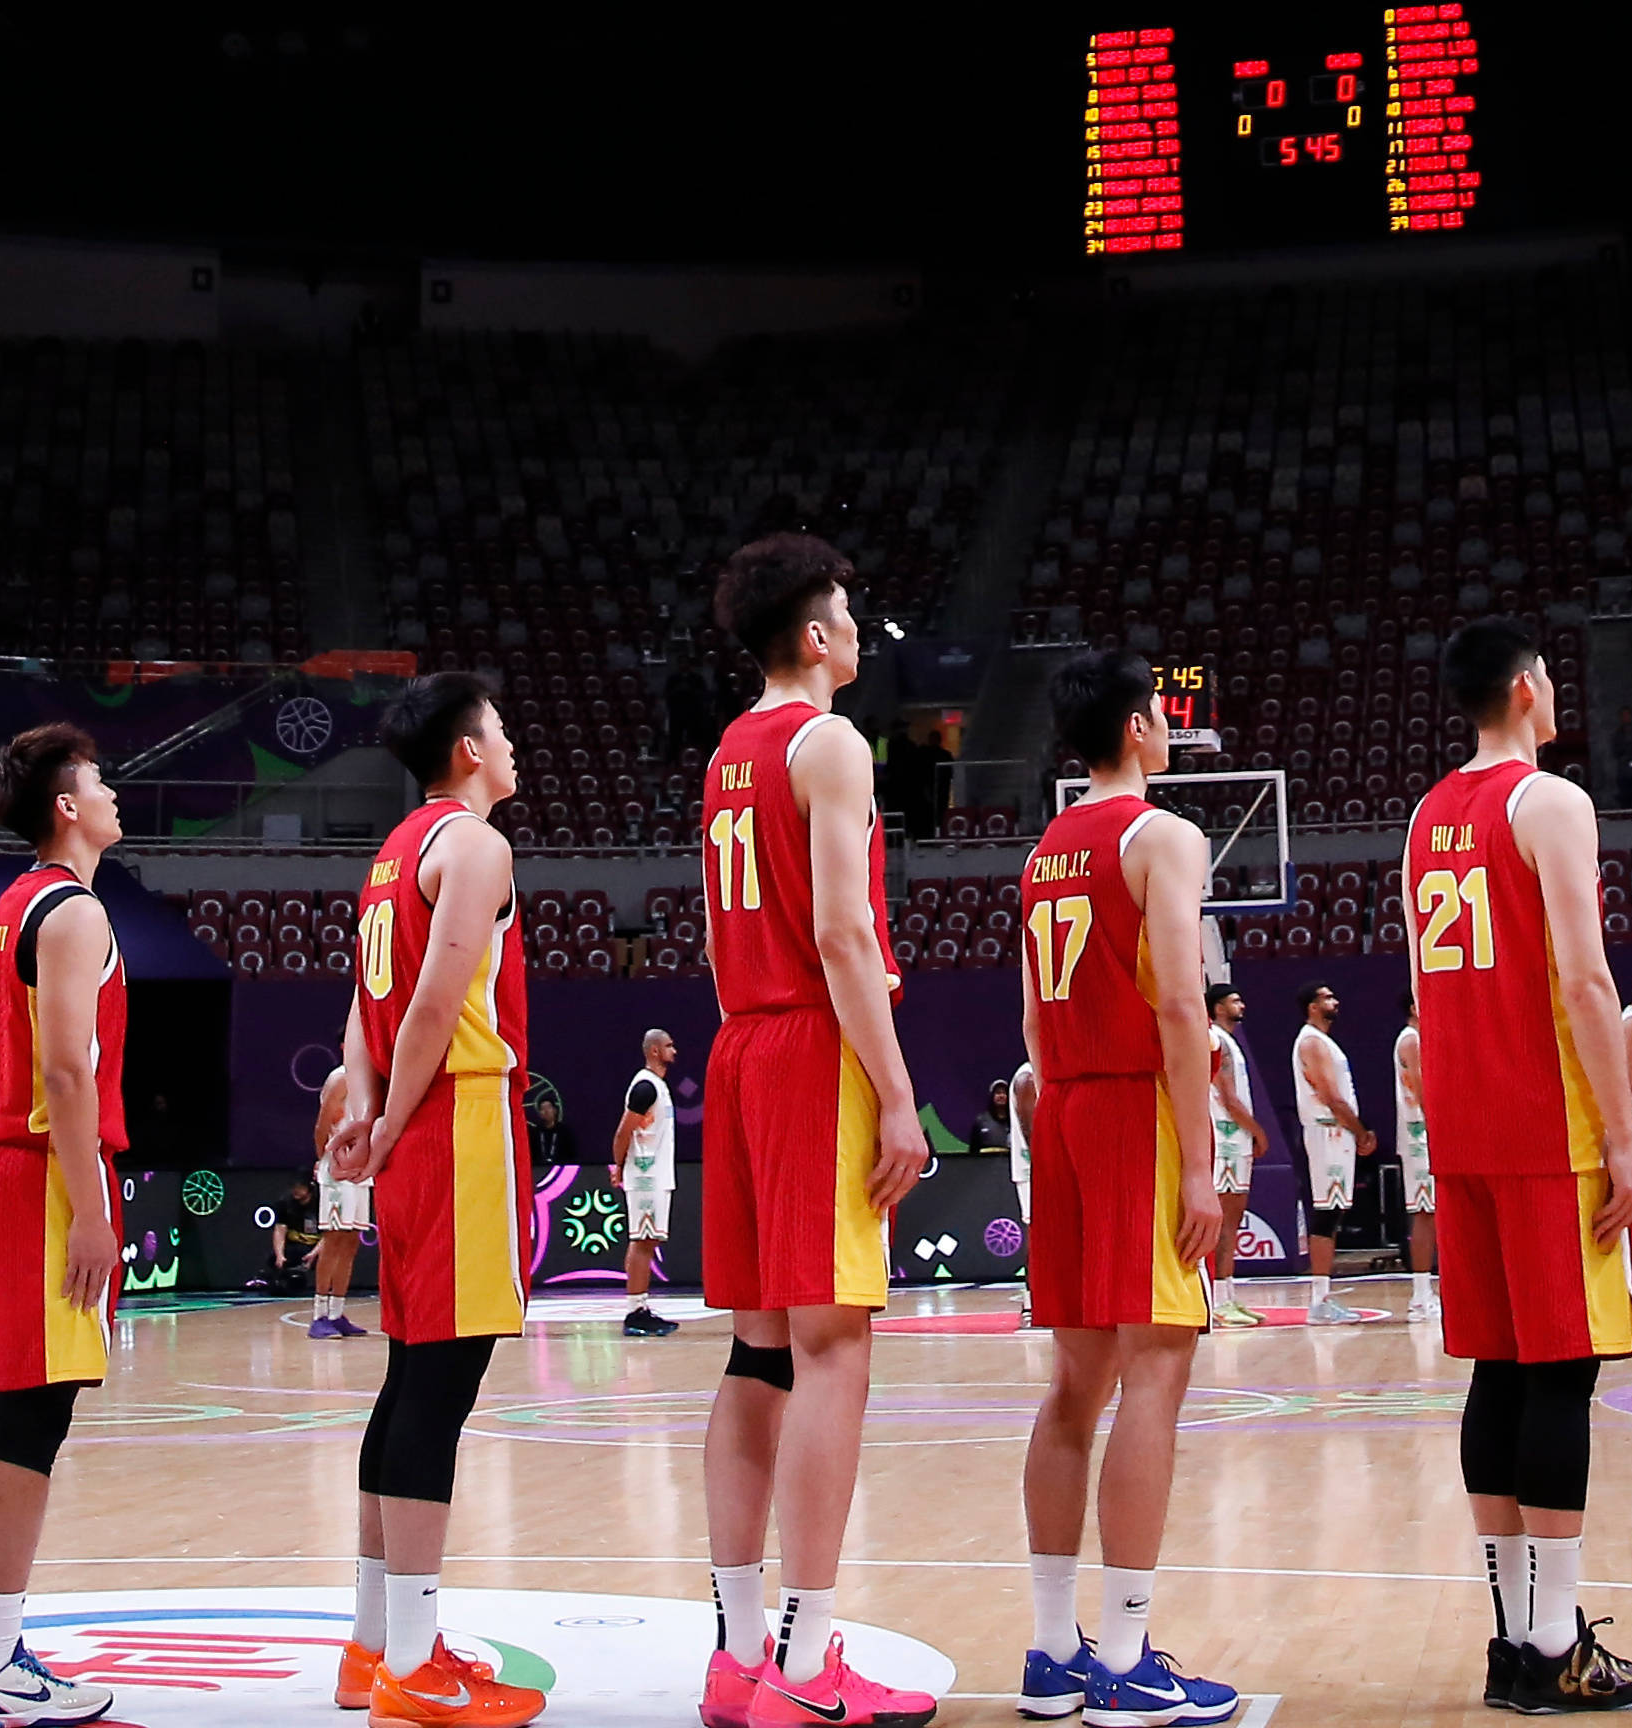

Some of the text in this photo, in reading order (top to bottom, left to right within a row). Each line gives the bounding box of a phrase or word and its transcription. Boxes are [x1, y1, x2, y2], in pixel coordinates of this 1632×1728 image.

[1086, 53, 1096, 66] 5
[1387, 46, 1397, 59] 5
[1266, 80, 1286, 108] 0
[1336, 74, 1356, 103] 0
[1238, 114, 1252, 135] 0
[1347, 105, 1361, 127] 0
[1388, 122, 1402, 135] 11
[1389, 140, 1404, 154] 17
[1087, 164, 1102, 177] 17
[1386, 160, 1405, 173] 21
[1084, 201, 1103, 215] 23
[1389, 197, 1407, 211] 35
[1085, 221, 1104, 234] 24
[1391, 216, 1409, 230] 39
[1086, 240, 1105, 253] 34
[1173, 666, 1203, 689] 45
[721, 764, 737, 791] YU
[1431, 826, 1454, 852] HU
[709, 806, 761, 911] 11
[1032, 850, 1091, 883] ZHAO J.Y.
[1417, 866, 1495, 973] 21
[358, 899, 394, 1000] 10
[1027, 895, 1093, 1002] 17
